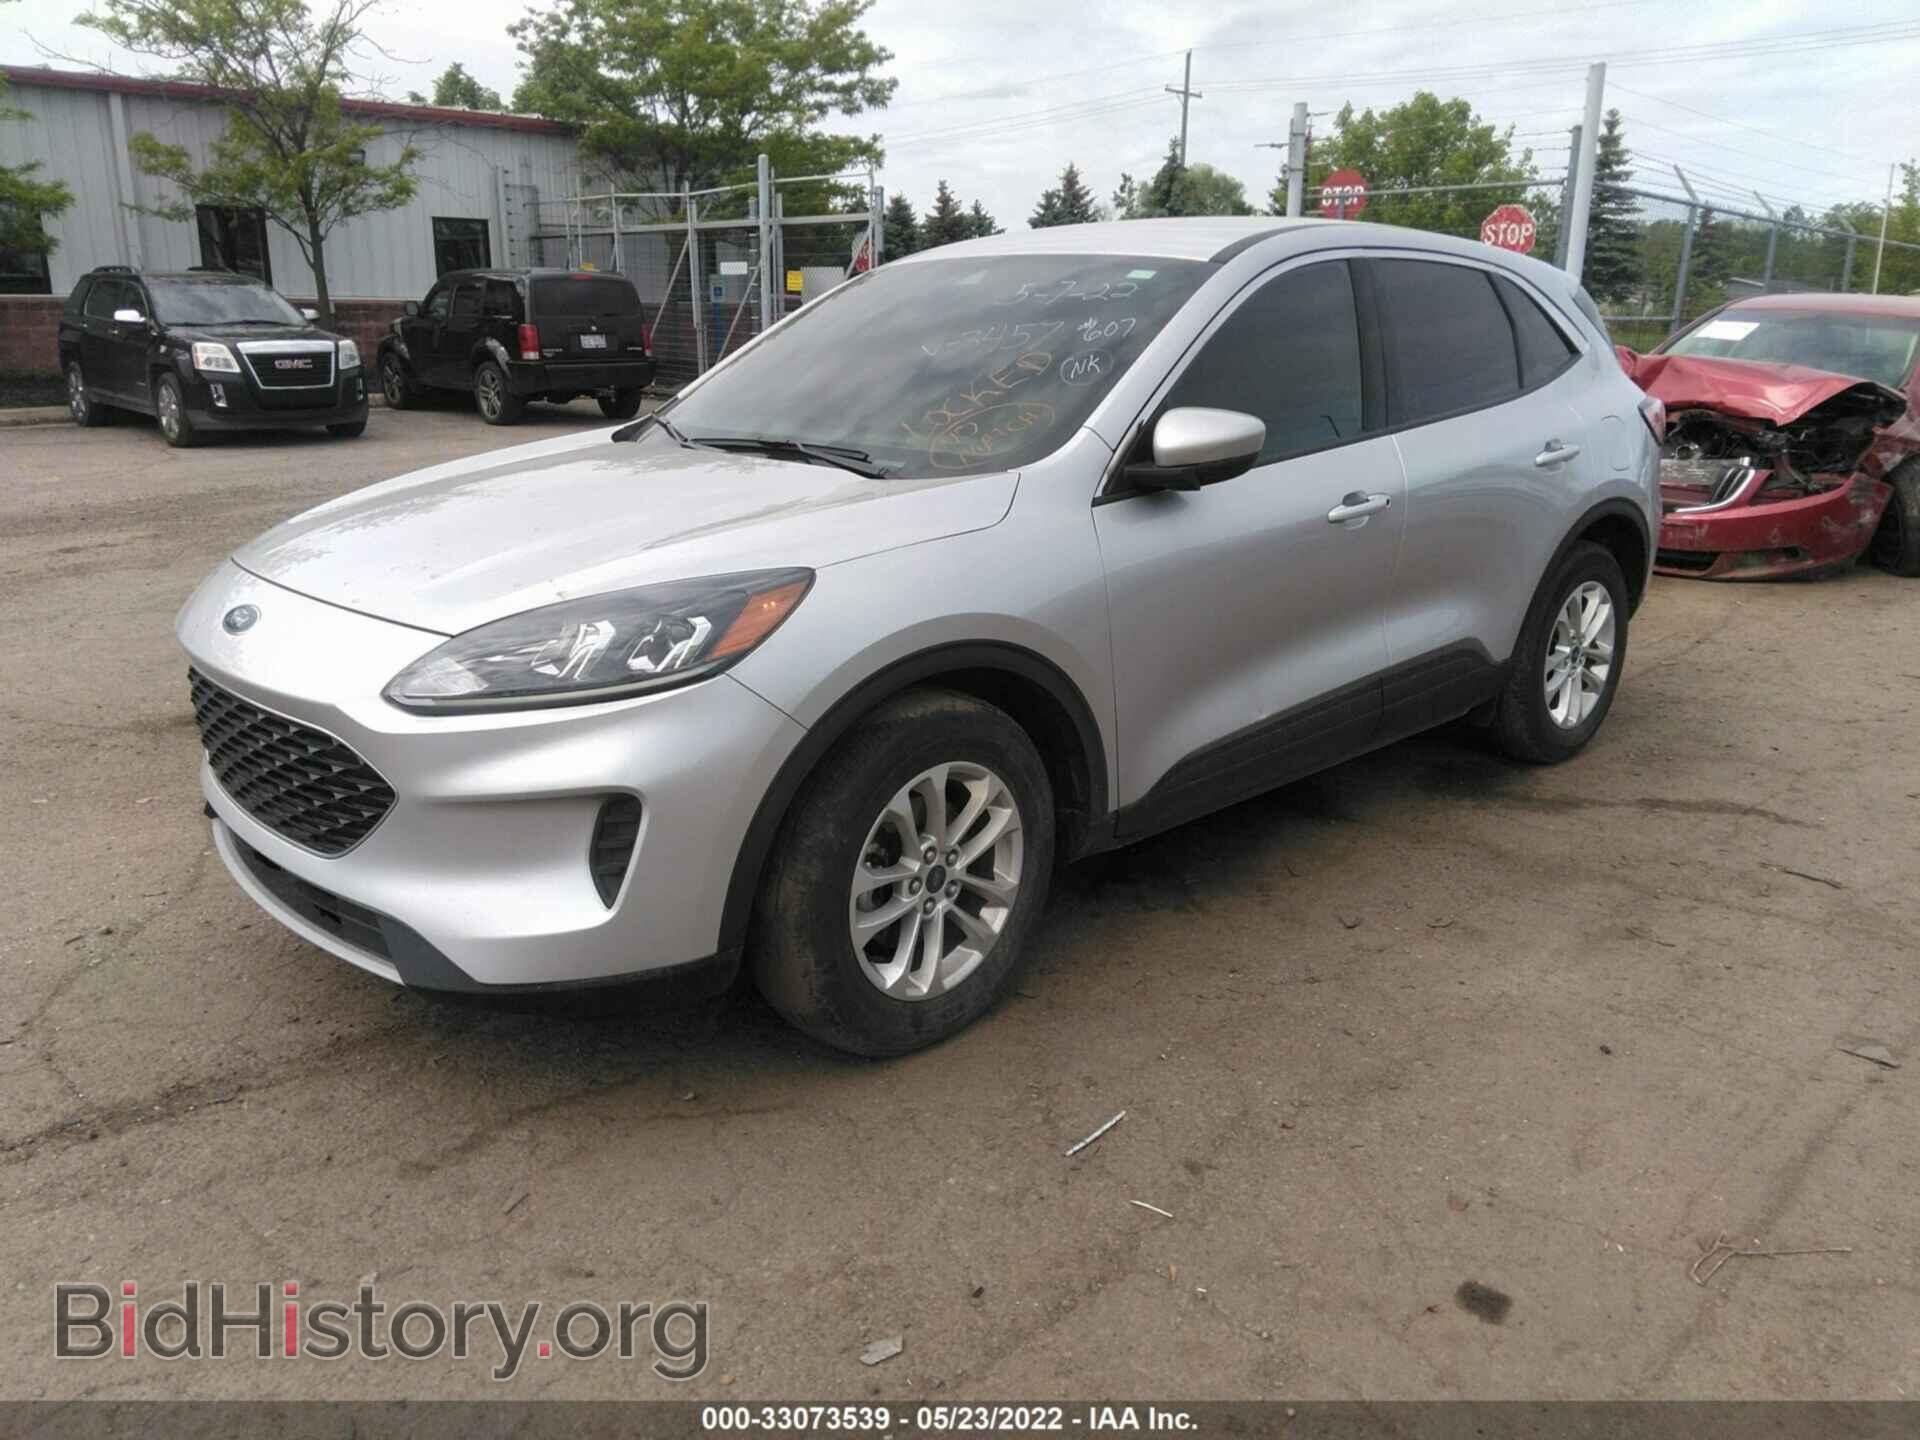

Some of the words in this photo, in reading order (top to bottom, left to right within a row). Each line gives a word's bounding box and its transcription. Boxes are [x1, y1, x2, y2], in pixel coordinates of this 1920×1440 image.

[1484, 222, 1534, 245] STOP
[274, 358, 313, 369] GMC
[1070, 354, 1101, 379] NK
